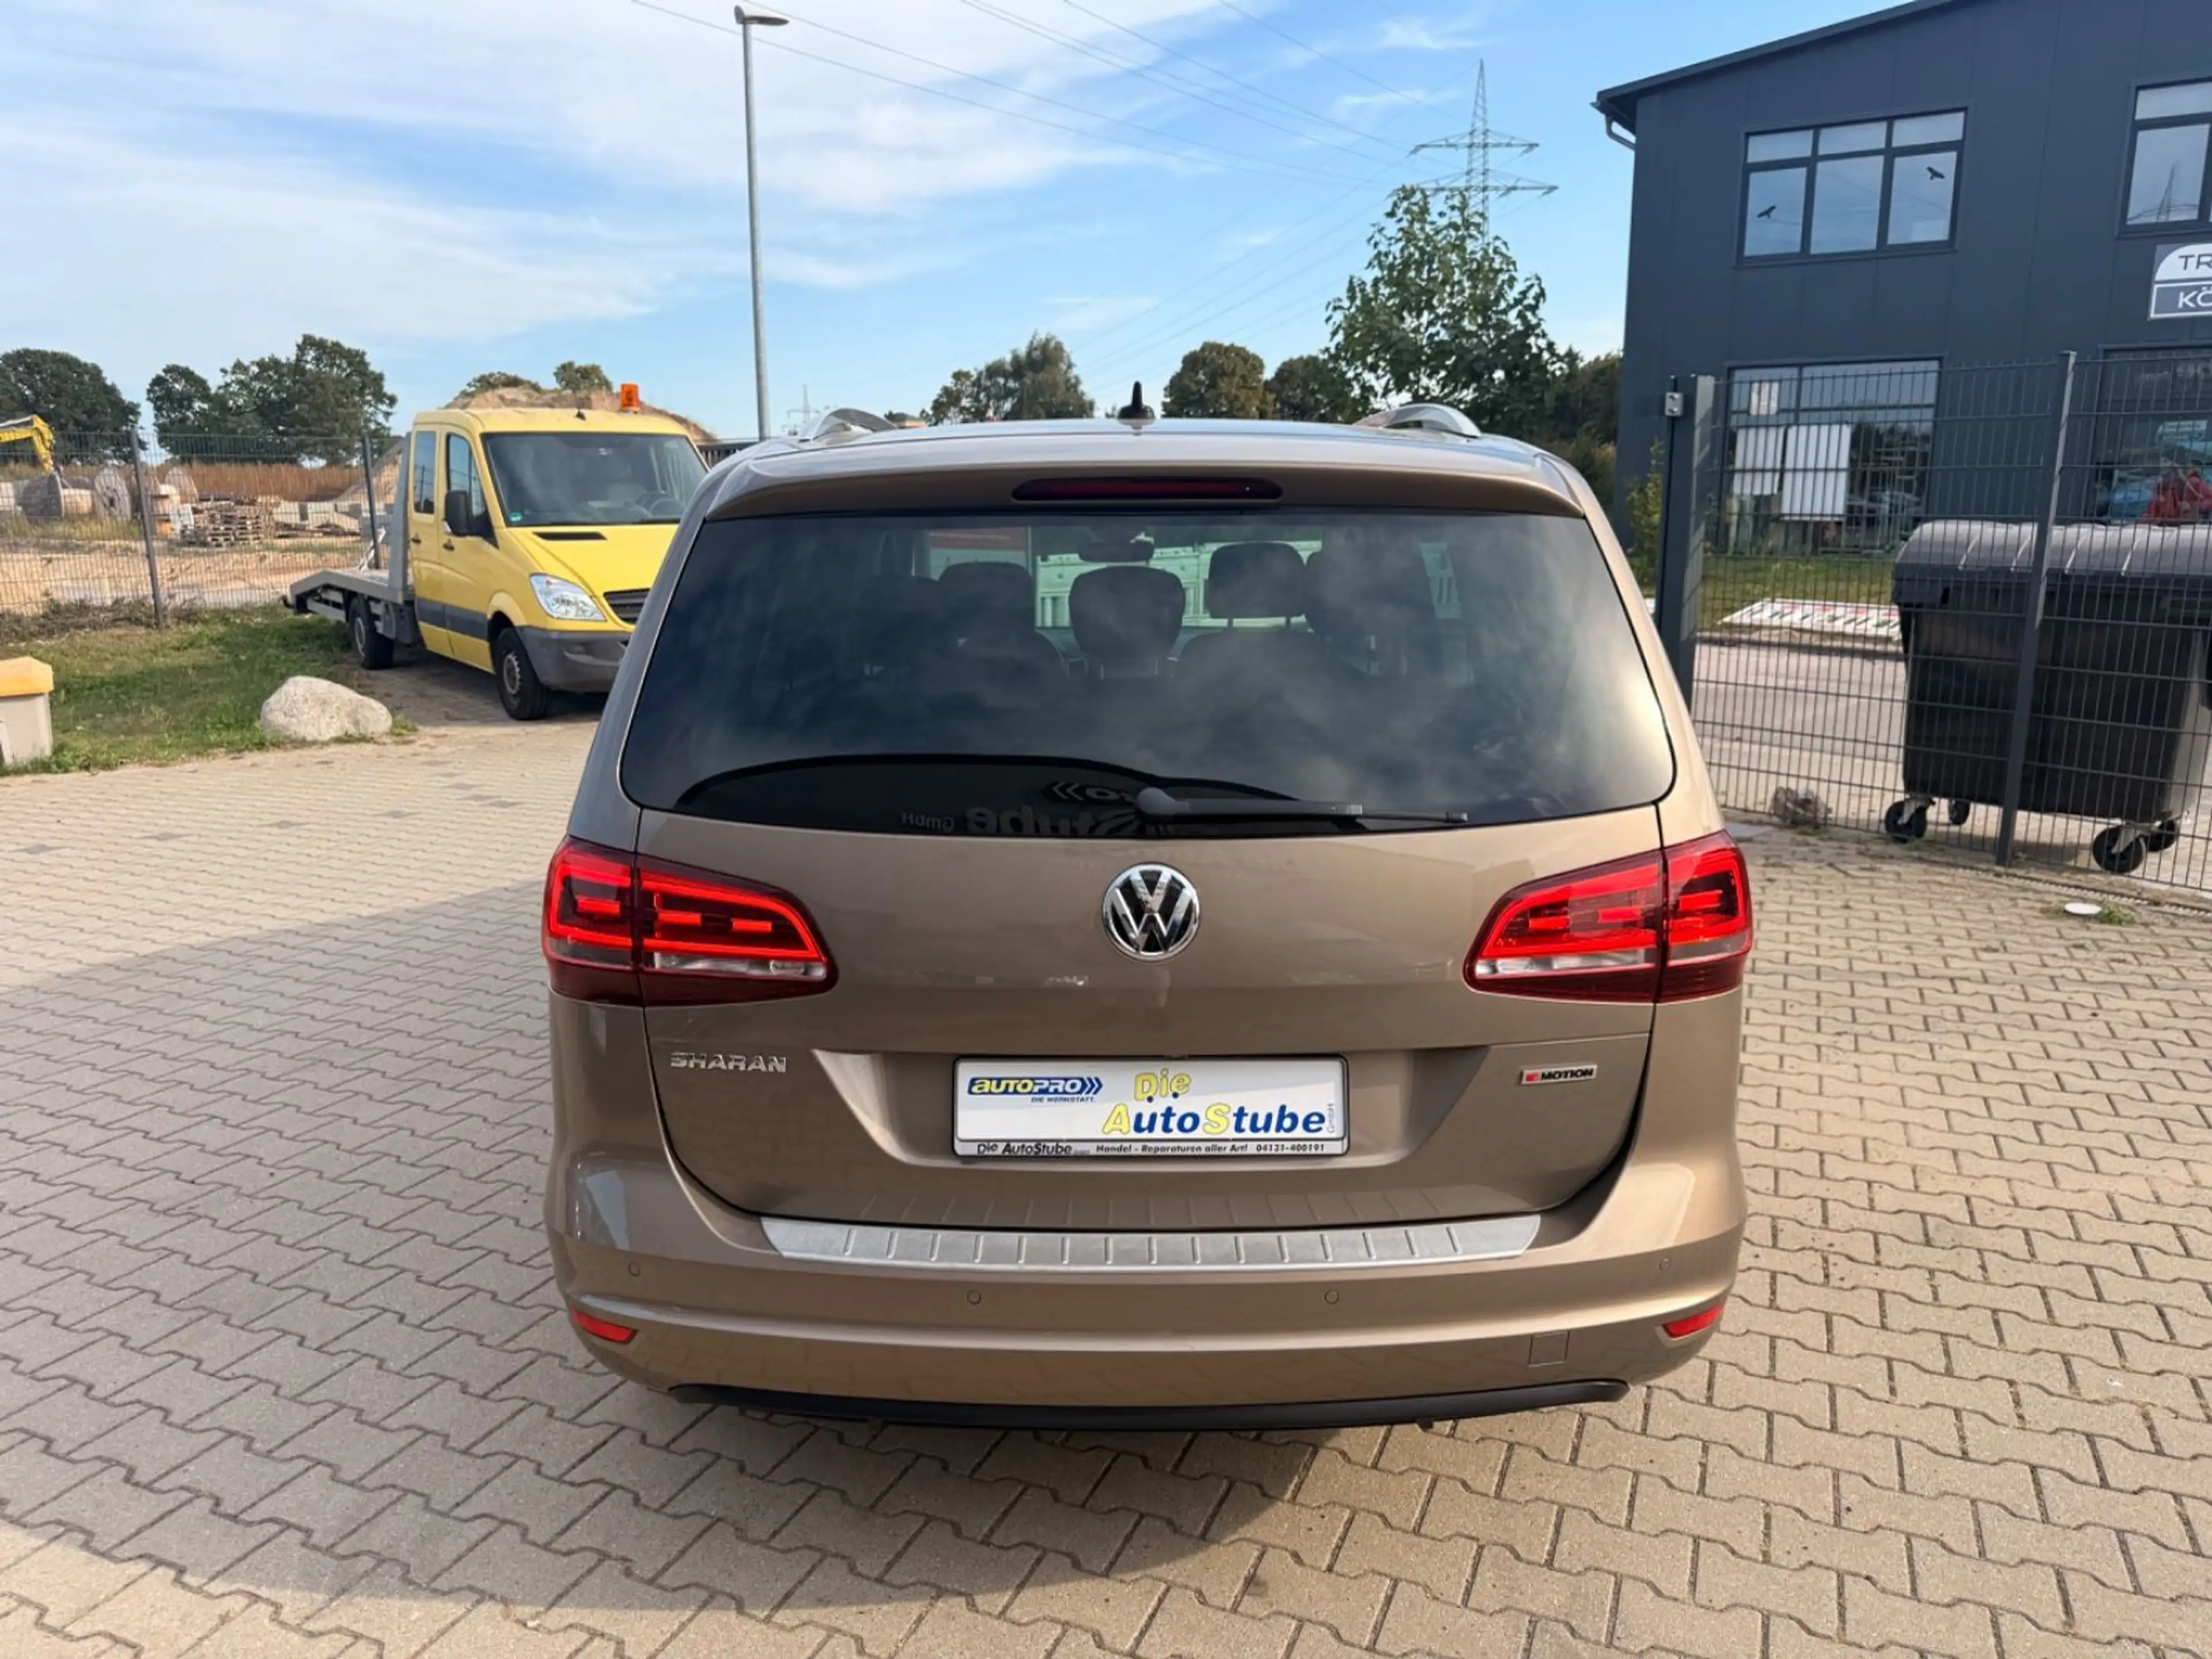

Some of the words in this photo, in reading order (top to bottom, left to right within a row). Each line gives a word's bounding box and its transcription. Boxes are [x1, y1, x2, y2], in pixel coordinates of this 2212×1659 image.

[670, 1051, 787, 1073] SHARAN
[1134, 1068, 1191, 1101] Die
[1102, 1103, 1325, 1135] AutoStube
[977, 1142, 998, 1153] Die
[1002, 1141, 1073, 1155] AutoStube
[1096, 1144, 1132, 1152] Handel
[1142, 1144, 1202, 1154] Reparaturen
[1205, 1143, 1228, 1152] aller
